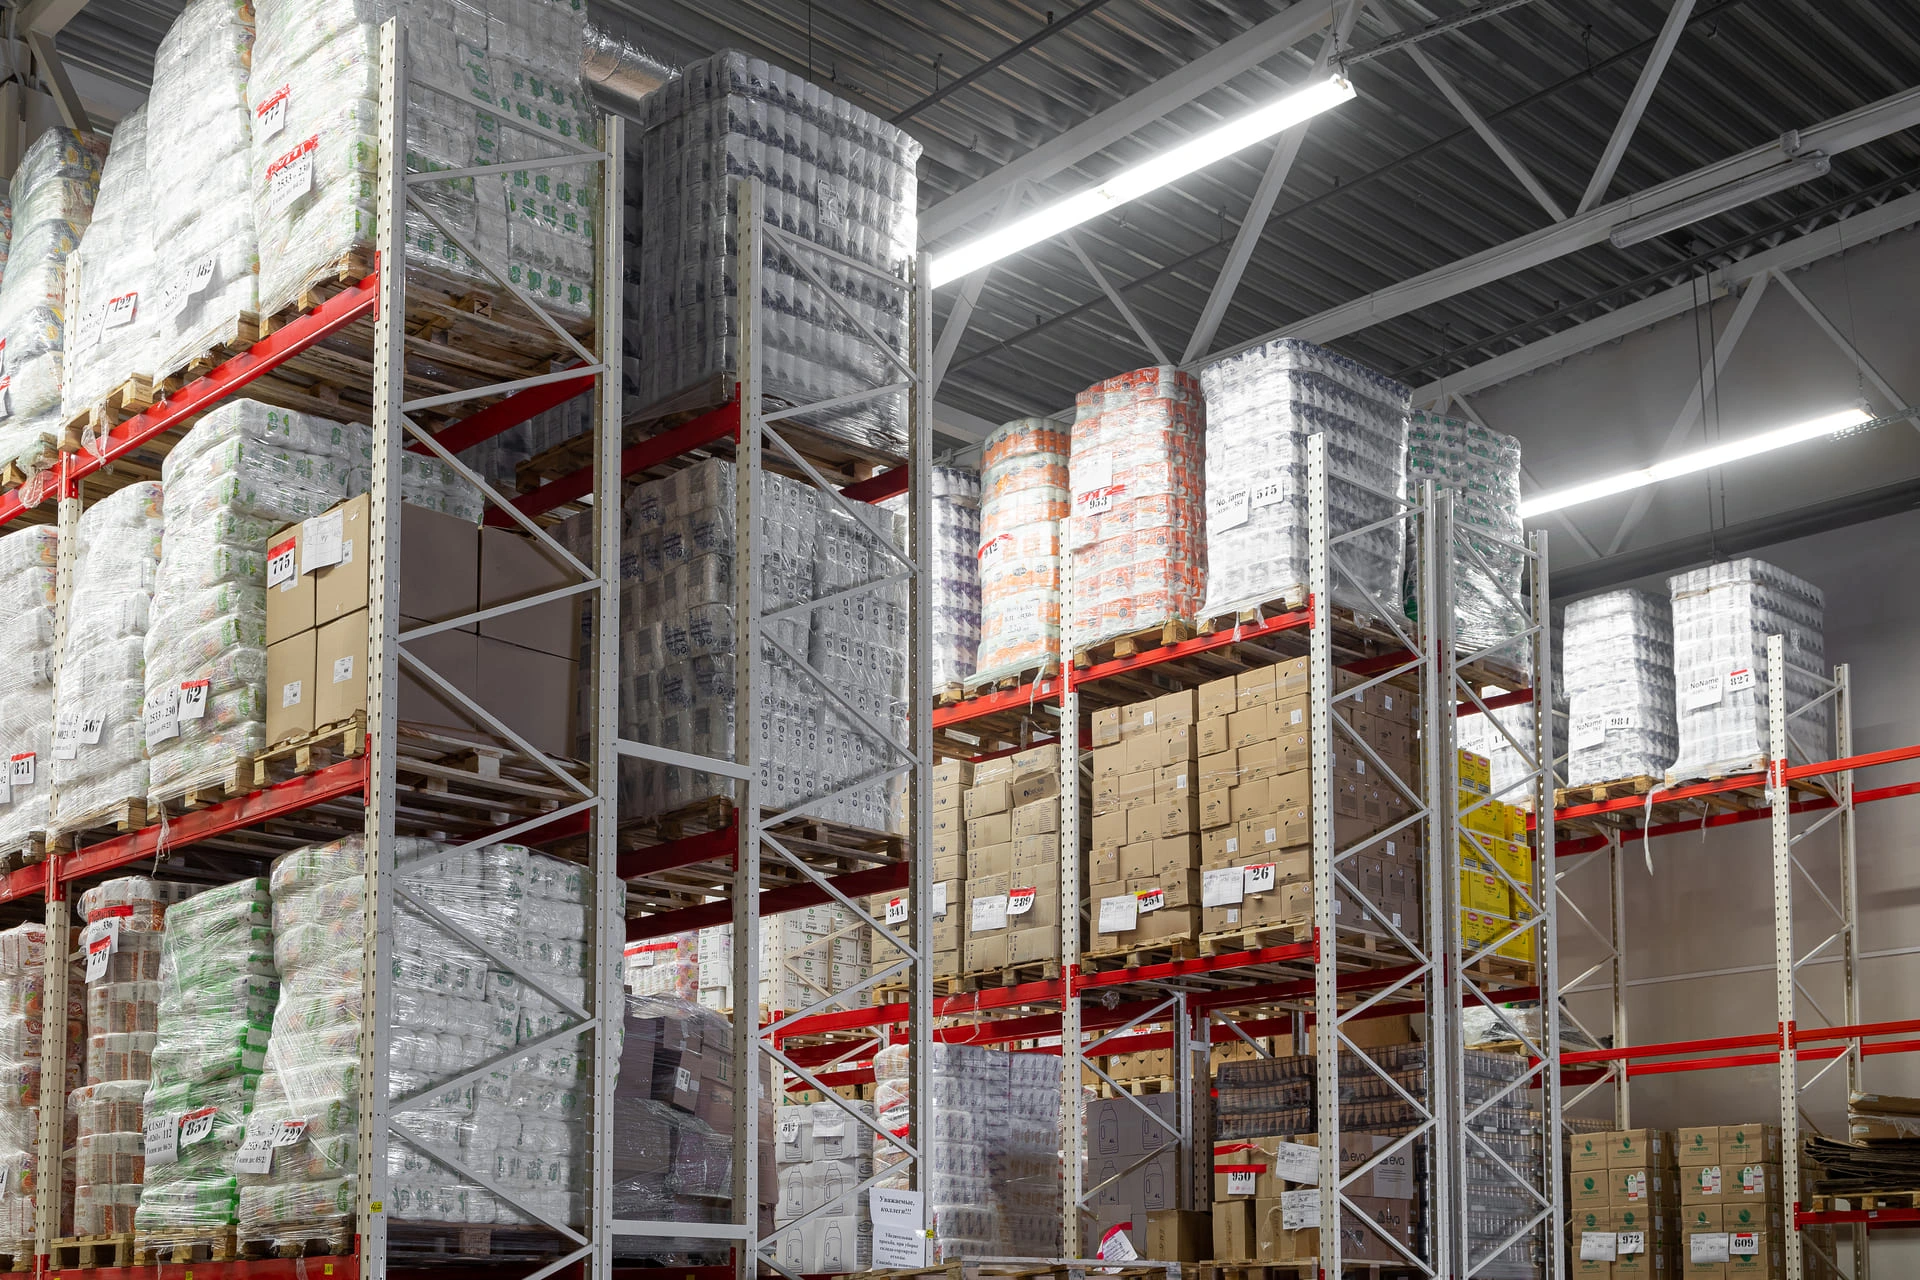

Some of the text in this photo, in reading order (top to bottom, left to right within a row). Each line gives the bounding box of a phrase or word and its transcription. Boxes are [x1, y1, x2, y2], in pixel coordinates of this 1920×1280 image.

[1257, 484, 1277, 499] 575
[273, 553, 290, 575] 775
[1690, 678, 1719, 689] NoName
[1730, 674, 1749, 686] 827
[186, 685, 202, 704] 62
[82, 720, 100, 733] 567
[14, 761, 30, 775] 871
[1253, 866, 1269, 880] 26
[1013, 896, 1031, 908] 289
[889, 905, 905, 917] 341
[92, 951, 107, 966] 776
[186, 1116, 209, 1136] 857
[163, 1128, 173, 1140] 112
[1232, 1171, 1251, 1181] 950
[1622, 1235, 1640, 1244] 972
[1734, 1239, 1754, 1248] 609
